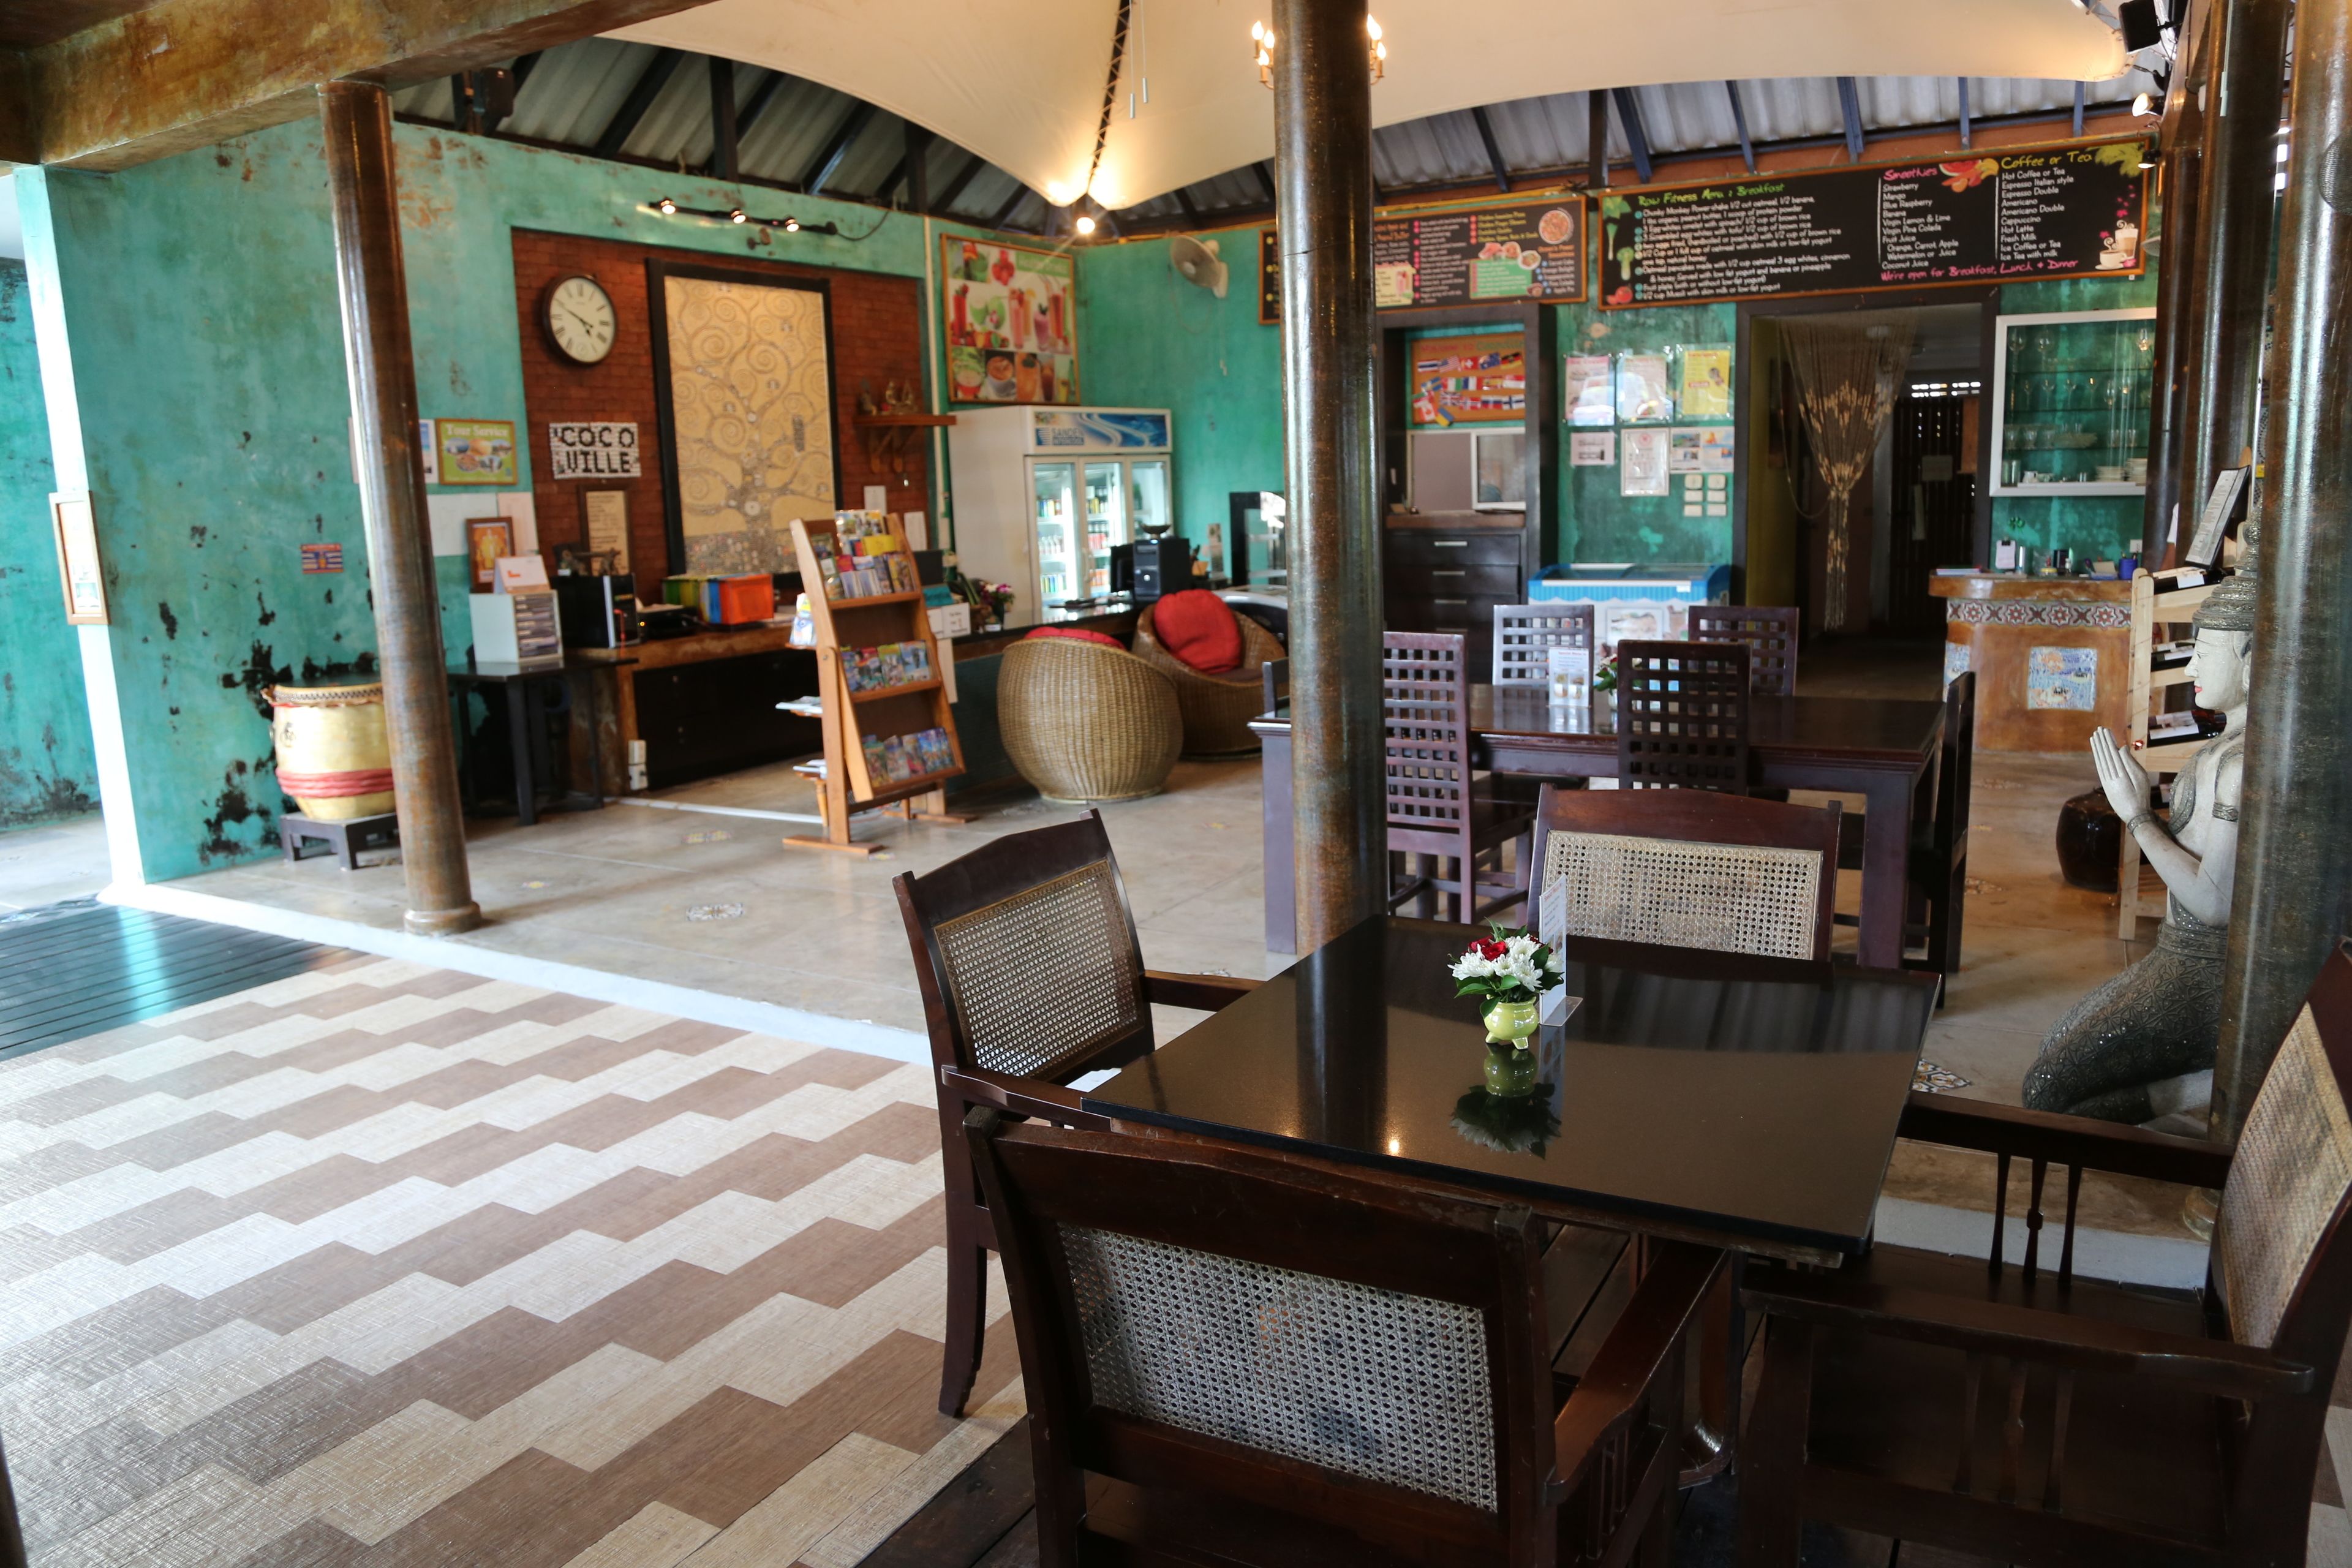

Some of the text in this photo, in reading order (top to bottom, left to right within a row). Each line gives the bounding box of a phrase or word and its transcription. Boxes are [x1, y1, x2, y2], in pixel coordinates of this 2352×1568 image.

[2001, 151, 2092, 169] Coffee or Tea
[1883, 167, 1937, 181] Smoothies
[2002, 172, 2015, 181] Hot
[2016, 170, 2041, 179] Coffee
[1882, 183, 1919, 192] Strawberry
[2002, 181, 2032, 190] Espresso
[2056, 175, 2075, 185] style
[1664, 192, 1698, 203] Fitness
[1736, 183, 1785, 197] Breakfast
[2002, 186, 2059, 199] Espresso Double
[2001, 198, 2038, 207] Americano
[2039, 203, 2065, 213] Double
[1882, 209, 1906, 218] Banana
[2000, 216, 2041, 225] Cappuccino
[1899, 234, 1916, 243] Juice
[1939, 239, 1959, 249] Apple
[2013, 242, 2037, 251] Coffee
[2048, 239, 2061, 248] Tea
[1887, 251, 1926, 260] Watermelon
[2043, 249, 2058, 257] milk
[1882, 259, 1929, 270] Coconut Juice
[1907, 271, 1927, 281] open
[1931, 267, 1945, 277] for
[1999, 261, 2033, 273] Lunch
[2047, 259, 2078, 270] Dinner
[562, 426, 634, 448] COCO
[567, 451, 630, 473] VILLE
